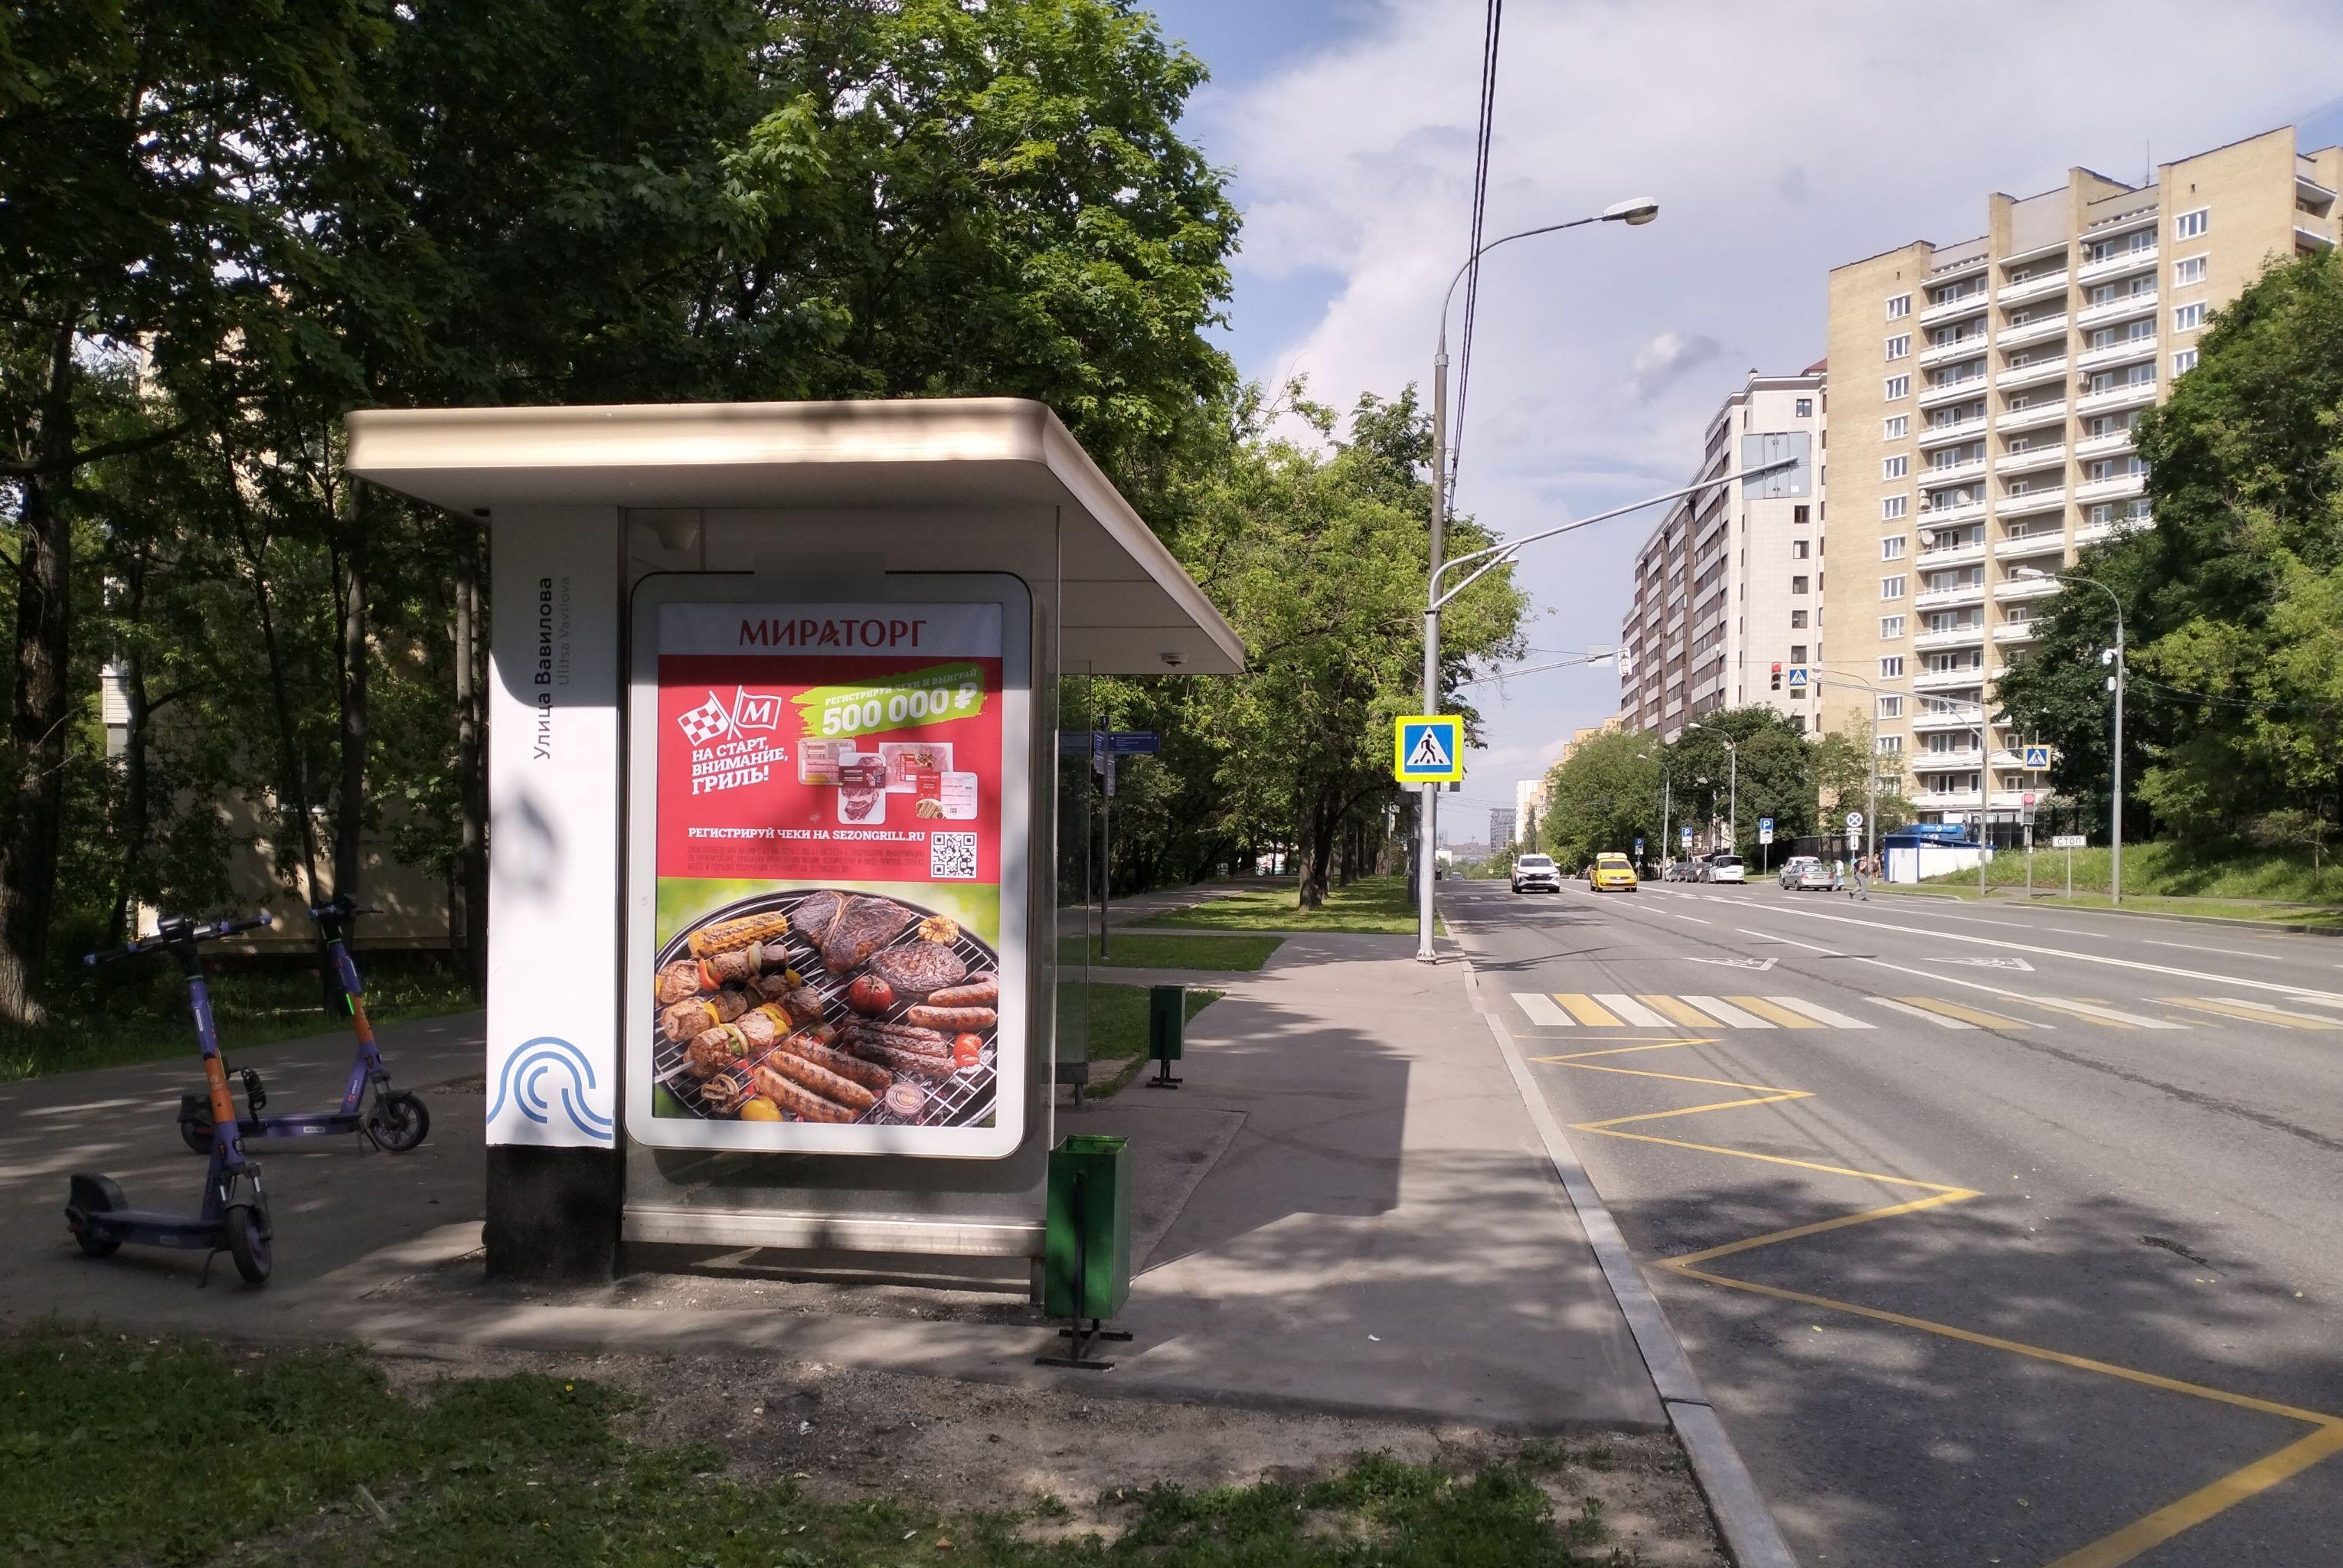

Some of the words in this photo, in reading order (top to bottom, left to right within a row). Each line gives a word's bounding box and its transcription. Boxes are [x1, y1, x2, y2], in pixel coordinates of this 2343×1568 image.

[558, 577, 570, 640] Vavilova
[534, 577, 552, 685] Вавилова
[739, 619, 927, 648] МИРАТОРГ
[558, 642, 570, 685] Ulitsa
[822, 700, 882, 736] 500
[888, 687, 949, 723] 000
[825, 686, 892, 706] РЕГИСТРИРУЙ
[534, 692, 554, 760] Улица
[691, 747, 714, 763] НА
[716, 736, 769, 758] СТАРТ,
[691, 747, 789, 777] ВНИМАНИЕ,
[691, 764, 770, 795] ГРИЛЬ!
[688, 827, 775, 839] РЕГИСТРИРУЙ
[776, 829, 810, 839] ЧЕКИ
[812, 830, 831, 840] НА
[832, 830, 925, 841] SEZONGRILL.RU
